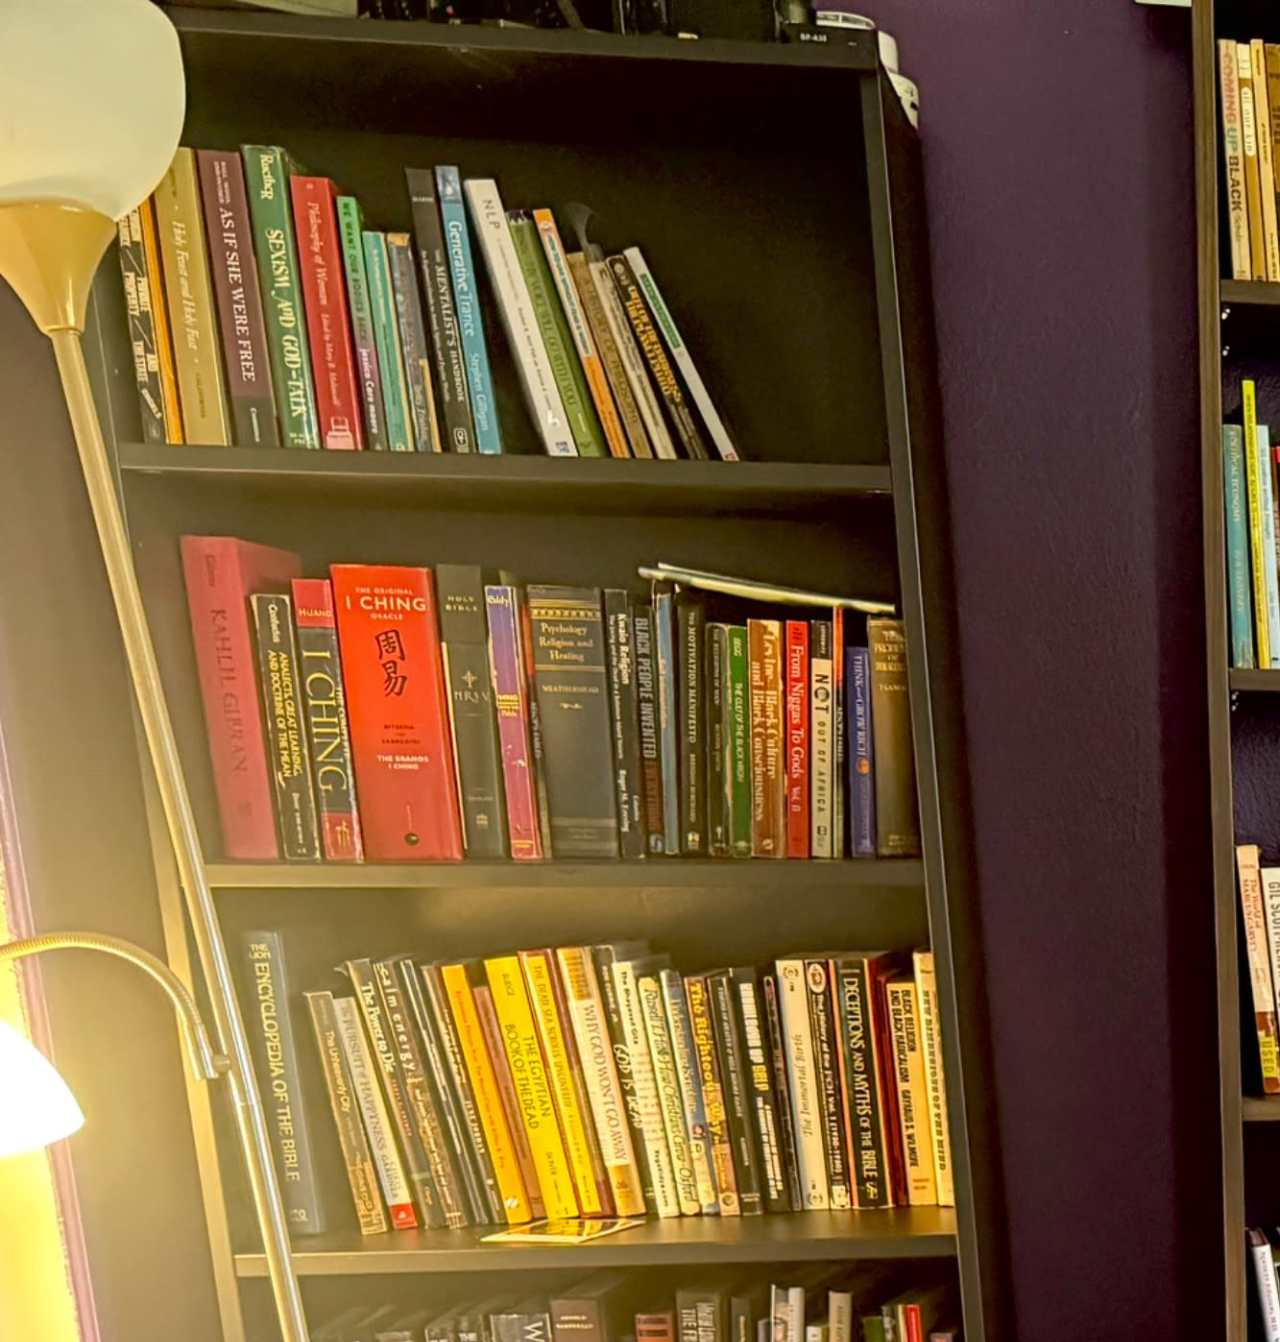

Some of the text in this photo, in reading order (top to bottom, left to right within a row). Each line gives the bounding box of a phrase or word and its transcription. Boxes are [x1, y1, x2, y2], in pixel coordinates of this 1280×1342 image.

[1222, 53, 1243, 212] COMING UP BLACK
[219, 208, 237, 230] AS
[222, 232, 238, 248] IF
[482, 200, 500, 229] NLP
[224, 251, 245, 284] SHE
[229, 287, 251, 335] WERE
[235, 339, 255, 381] FREE
[448, 221, 490, 431] Generative Trance Stephen Gilligan
[305, 672, 346, 794] CHING
[635, 618, 657, 758] BLACK PEOPLE INVENTED
[789, 645, 804, 778] From Niggas To Gods
[504, 1024, 540, 1129] BOOK OF THE DEAD
[524, 1035, 552, 1118] THE EGYPTIAN
[582, 1005, 628, 1161] WHY GOD WON'T GO AWAY
